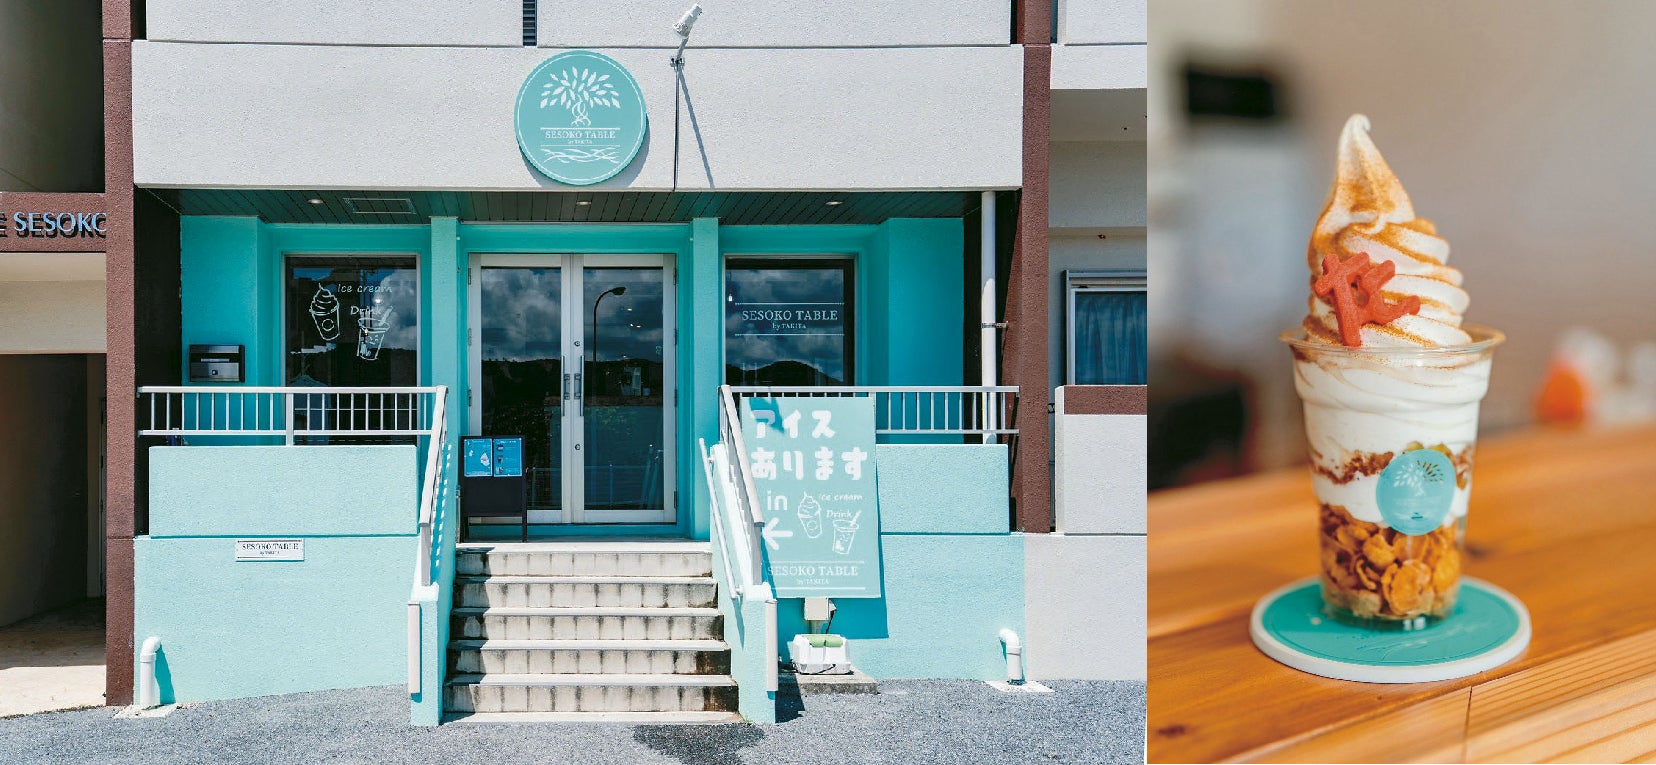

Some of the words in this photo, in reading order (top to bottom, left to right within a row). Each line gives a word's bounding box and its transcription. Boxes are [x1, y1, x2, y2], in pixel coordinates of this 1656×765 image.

[544, 131, 582, 139] SESOKO
[585, 131, 616, 139] TABLE
[337, 284, 353, 293] Ice
[357, 285, 393, 293] cream
[350, 305, 382, 315] Drink
[742, 310, 792, 320] SESOKO
[796, 310, 838, 320] TABLE
[772, 323, 780, 331] by
[751, 409, 836, 439] アイス
[750, 446, 868, 481] あります
[767, 490, 788, 511] in
[826, 509, 853, 518] Drink
[768, 565, 815, 576] SESOKO
[818, 565, 858, 576] TABLE
